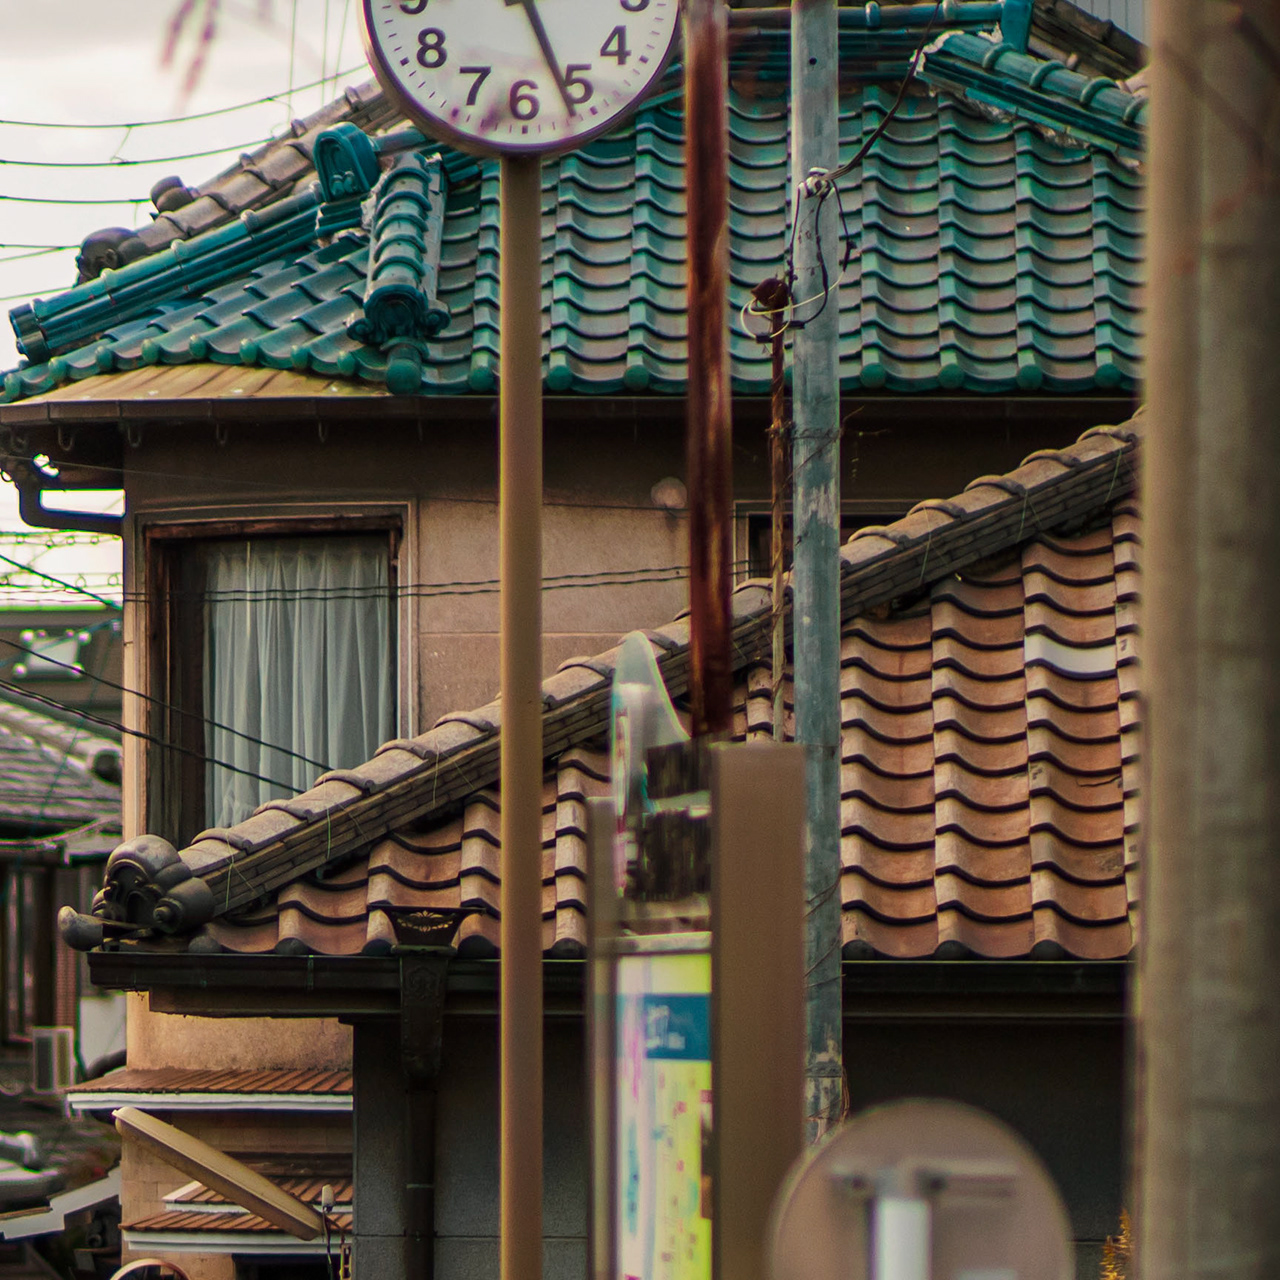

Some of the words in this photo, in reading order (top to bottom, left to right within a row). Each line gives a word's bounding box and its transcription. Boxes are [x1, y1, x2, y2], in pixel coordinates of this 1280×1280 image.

[417, 27, 447, 68] 8
[600, 25, 632, 65] 4
[460, 66, 491, 106] 7
[509, 79, 540, 120] 6
[565, 63, 594, 104] 5
